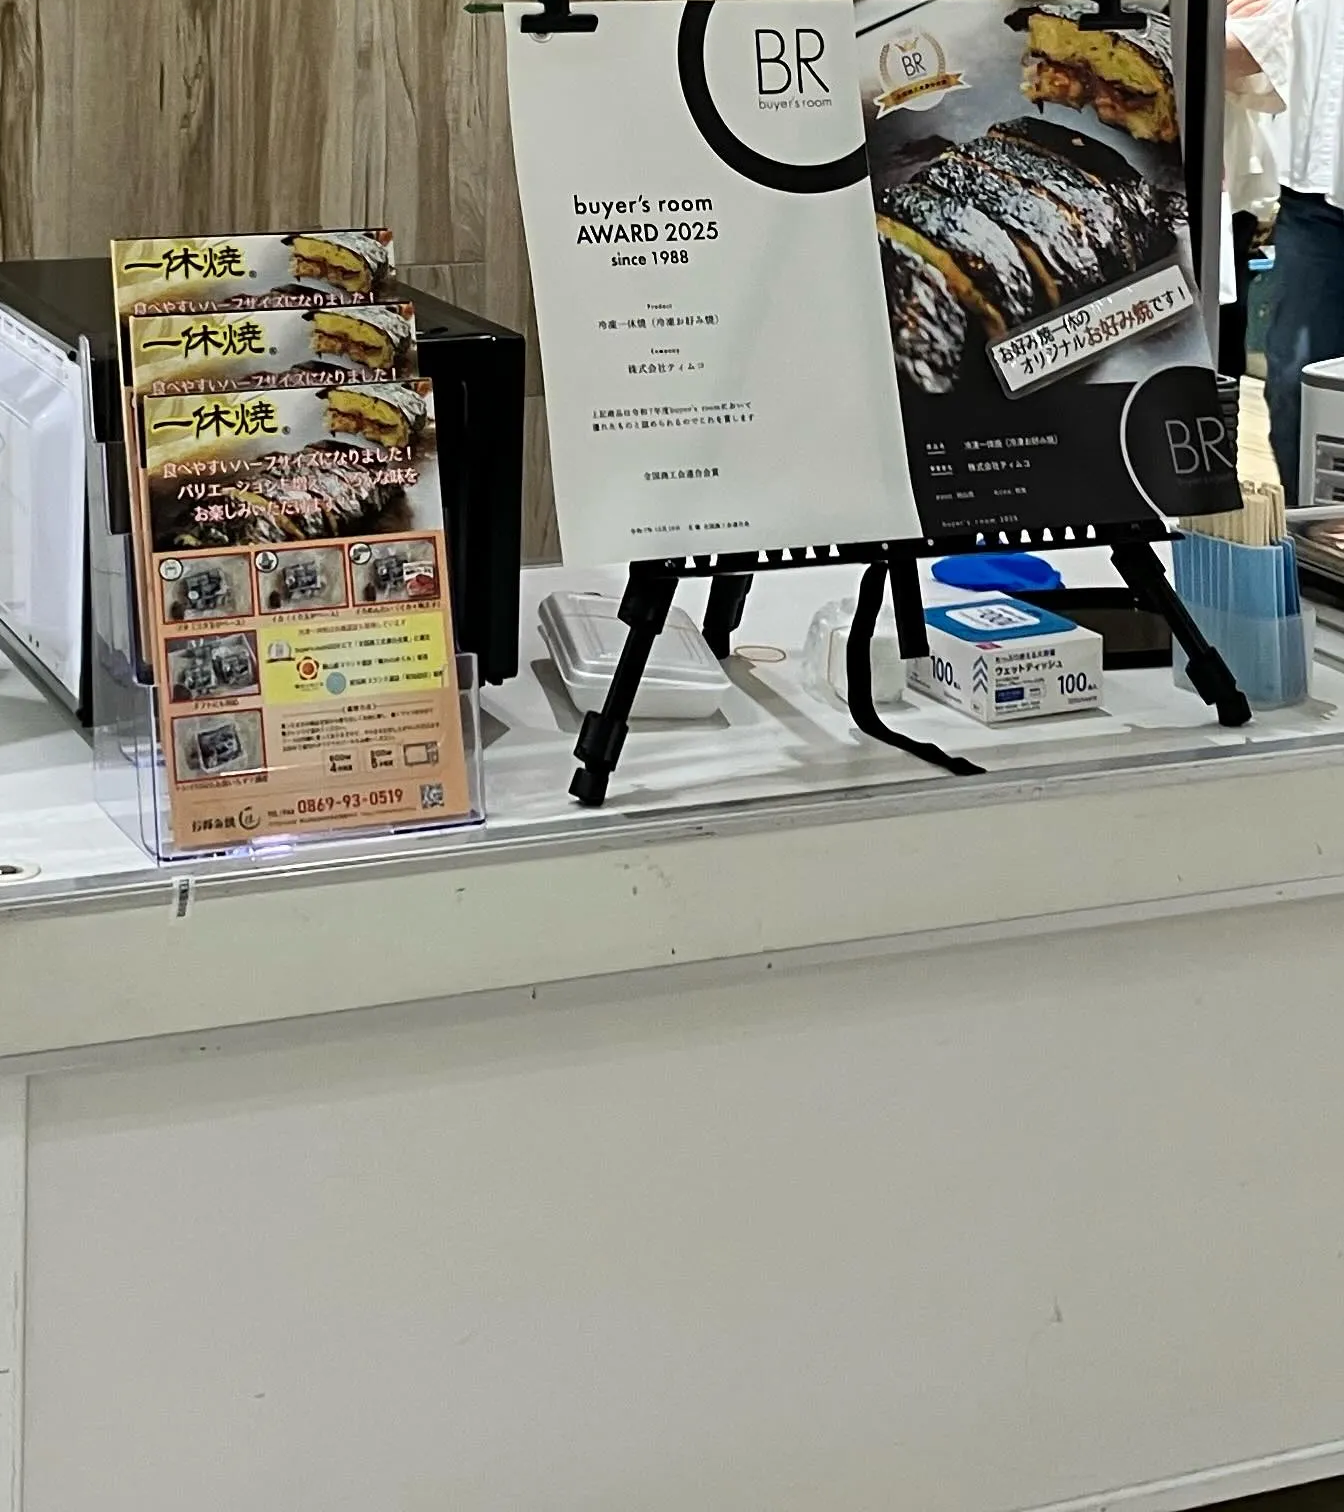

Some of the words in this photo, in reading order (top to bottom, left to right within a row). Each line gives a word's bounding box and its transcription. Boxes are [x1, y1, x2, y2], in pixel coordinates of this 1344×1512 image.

[755, 29, 830, 94] BR
[902, 52, 926, 76] BR
[758, 96, 800, 112] buyer's
[802, 98, 832, 108] room
[573, 195, 651, 219] buyer's
[658, 198, 713, 212] room
[577, 224, 659, 244] AWARD
[664, 221, 719, 242] 2025
[124, 245, 246, 281] 一休焼
[611, 252, 647, 266] since
[651, 249, 689, 265] 1988
[142, 321, 265, 358] 一休焼
[999, 310, 1091, 364] お好み焼一休の
[152, 401, 278, 439] 一休焼
[1165, 417, 1234, 474] BR
[930, 655, 953, 686] 100
[1057, 672, 1087, 695] 100
[297, 788, 404, 815] 0869-93-0519
